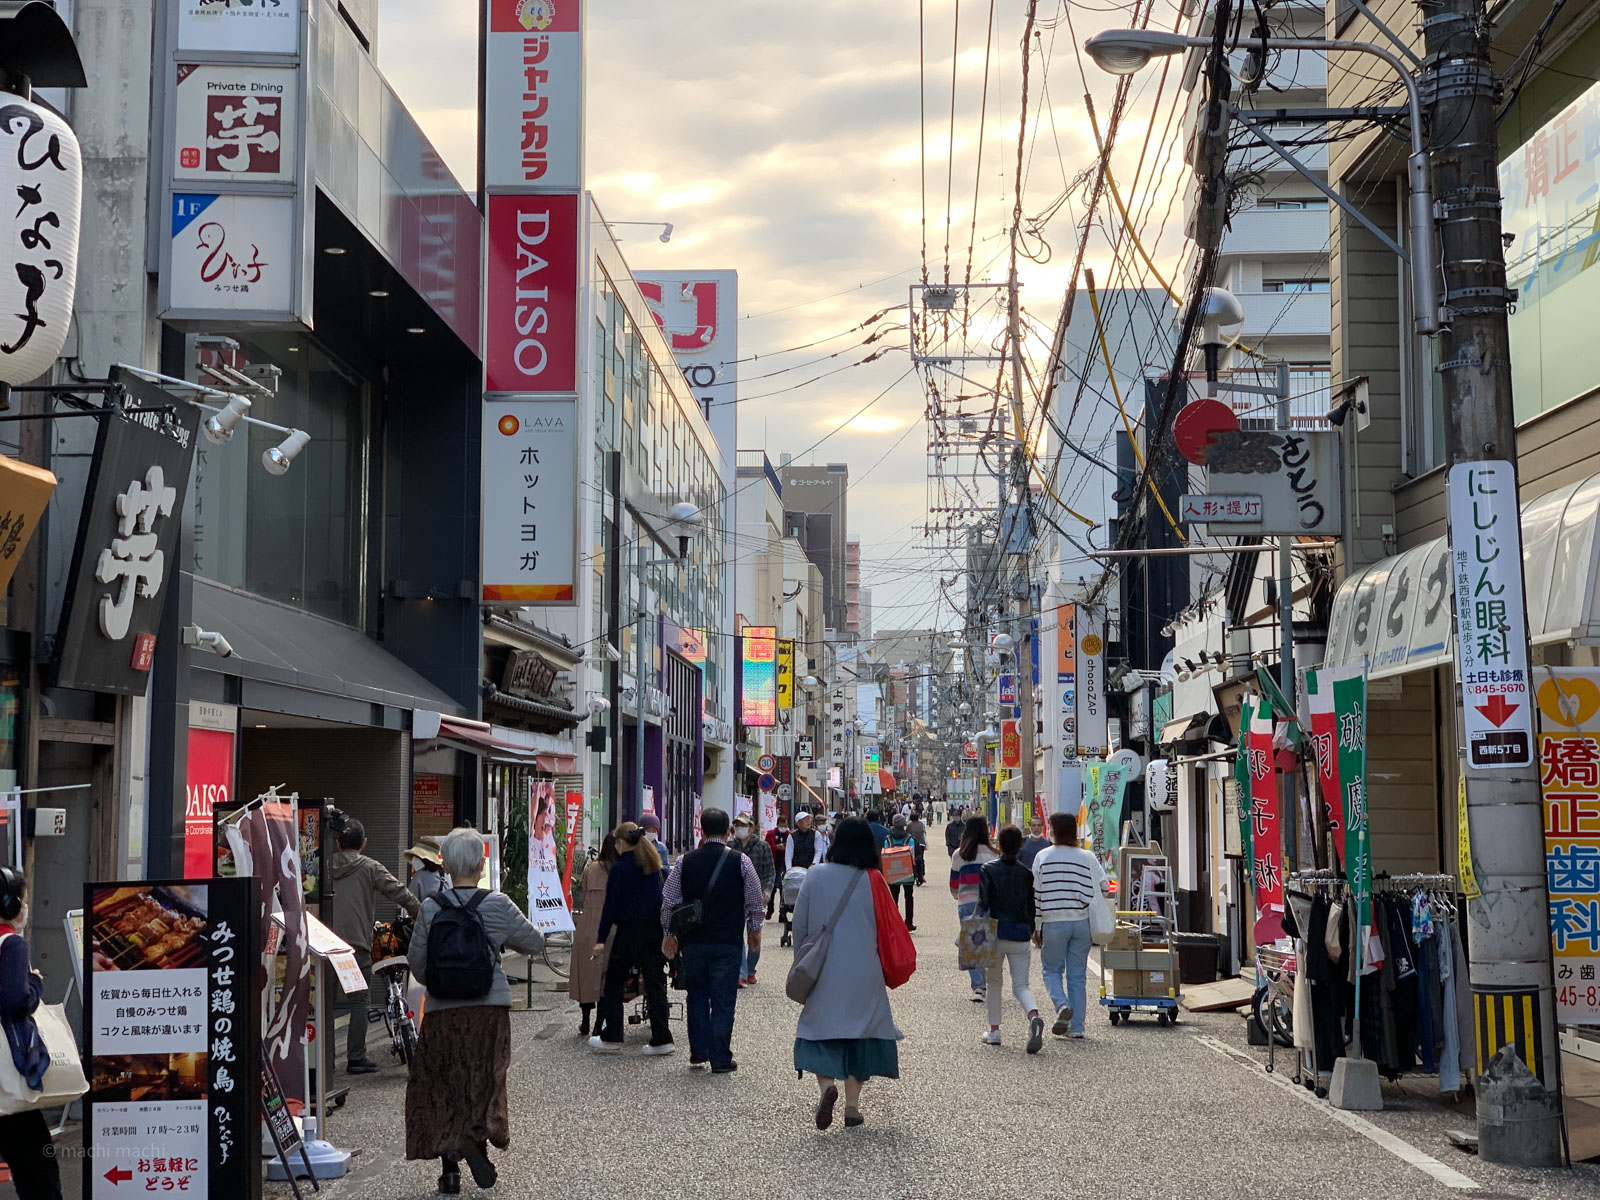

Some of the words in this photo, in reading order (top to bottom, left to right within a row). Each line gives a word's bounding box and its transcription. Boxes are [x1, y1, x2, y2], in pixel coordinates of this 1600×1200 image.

[207, 82, 247, 91] Private
[250, 83, 284, 94] Dining
[520, 35, 550, 181] ジャンカラ
[206, 97, 280, 172] 芋
[176, 199, 201, 217] 1F
[196, 222, 269, 283] ひなっ子
[214, 284, 250, 293] みつせ鶏
[513, 209, 550, 376] DAISO
[524, 417, 564, 428] LAVA
[1280, 434, 1325, 529] さとう
[519, 446, 541, 571] ホットヨガ
[1468, 469, 1511, 666] にしじん眼科
[1466, 669, 1524, 684] 土日も診療
[1086, 659, 1097, 716] chocoZAP
[1474, 683, 1526, 694] 845-5670
[1086, 746, 1100, 754] 24h
[1479, 744, 1521, 755] 西新5丁目
[761, 759, 772, 768] 30
[1101, 770, 1121, 809] 昼呑み
[1540, 738, 1600, 953] 矯正歯科
[100, 986, 203, 1000] 佐賀から毎日仕入れる
[115, 1005, 188, 1018] 自慢のみつせ鶏
[211, 920, 237, 1093] みつせ鶏の焼鳥
[100, 1023, 203, 1037] コクと風味が違います
[101, 1126, 138, 1137] 営業時間
[213, 1105, 234, 1165] ひなっ子
[137, 1157, 199, 1172] お気軽に
[144, 1175, 192, 1191] どうぞ
